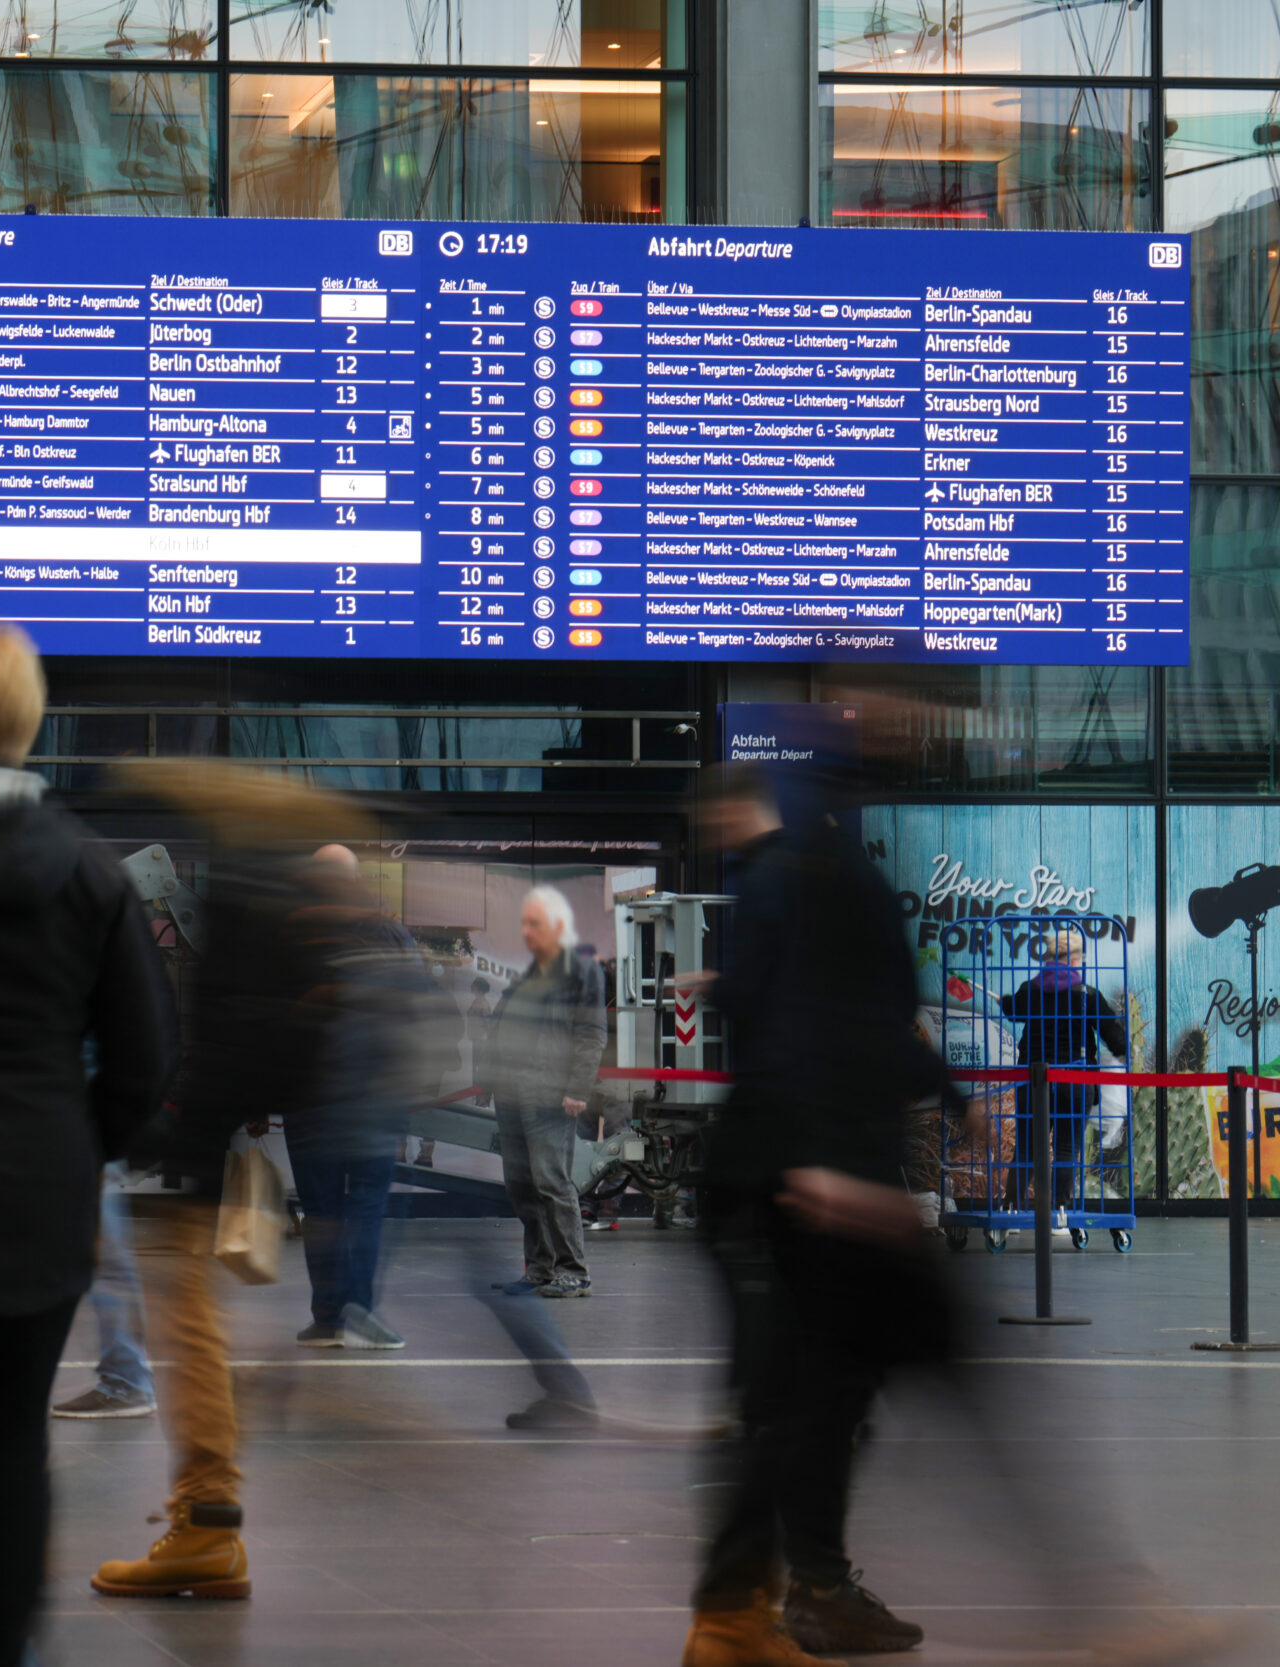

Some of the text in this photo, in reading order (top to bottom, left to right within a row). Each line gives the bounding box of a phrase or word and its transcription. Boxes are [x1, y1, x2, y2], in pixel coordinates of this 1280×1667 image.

[381, 234, 410, 254] DB
[477, 233, 528, 255] 17:19
[647, 236, 793, 262] Abfahrt Departure
[1151, 246, 1179, 266] DB
[149, 292, 263, 315] Schwedt (Oder)
[924, 303, 1032, 327] Berlin-Spandau
[1107, 306, 1128, 325] 16
[149, 322, 212, 347] Jüterbog
[924, 333, 1011, 353] Ahrensfelde
[149, 352, 281, 373] Berlin Ostbahnhof
[924, 363, 1077, 388] Berlin-Charlottenburg
[149, 383, 196, 402] Nauen
[924, 393, 1040, 417] Strausberg Nord
[149, 413, 267, 437] Hamburg-Altona
[924, 423, 999, 443] Westkreuz
[174, 443, 281, 467] Flughafen BER
[646, 451, 835, 469] Hackescher Markt Ostkreuz Köpenick
[924, 452, 971, 472] Erkner
[41, 475, 94, 489] Greifswald
[149, 473, 248, 494] Stralsund Hbf
[646, 481, 865, 498] Hackescher Markt Schöneweide Schönefeld
[949, 483, 1053, 506] Flughafen BER
[148, 503, 271, 528] Brandenburg Hbf
[924, 512, 1015, 532] Potsdam Hbf
[924, 542, 1010, 562] Ahrensfelde
[148, 564, 238, 588] Senftenberg
[460, 566, 504, 586] 10 min
[923, 572, 1031, 595] Berlin-Spandau
[148, 594, 211, 614] Köln Hbf
[923, 602, 1062, 625] Hoppegarten(Mark)
[148, 624, 262, 645] Berlin Südkreuz
[460, 627, 504, 646] 16 min
[924, 632, 998, 651] Westkreuz
[731, 734, 777, 748] Abfahrt
[731, 749, 813, 761] Departure Départ
[927, 853, 1095, 912] Your Stars
[897, 890, 1136, 943] OMING SOON
[916, 921, 1050, 962] FOR YO
